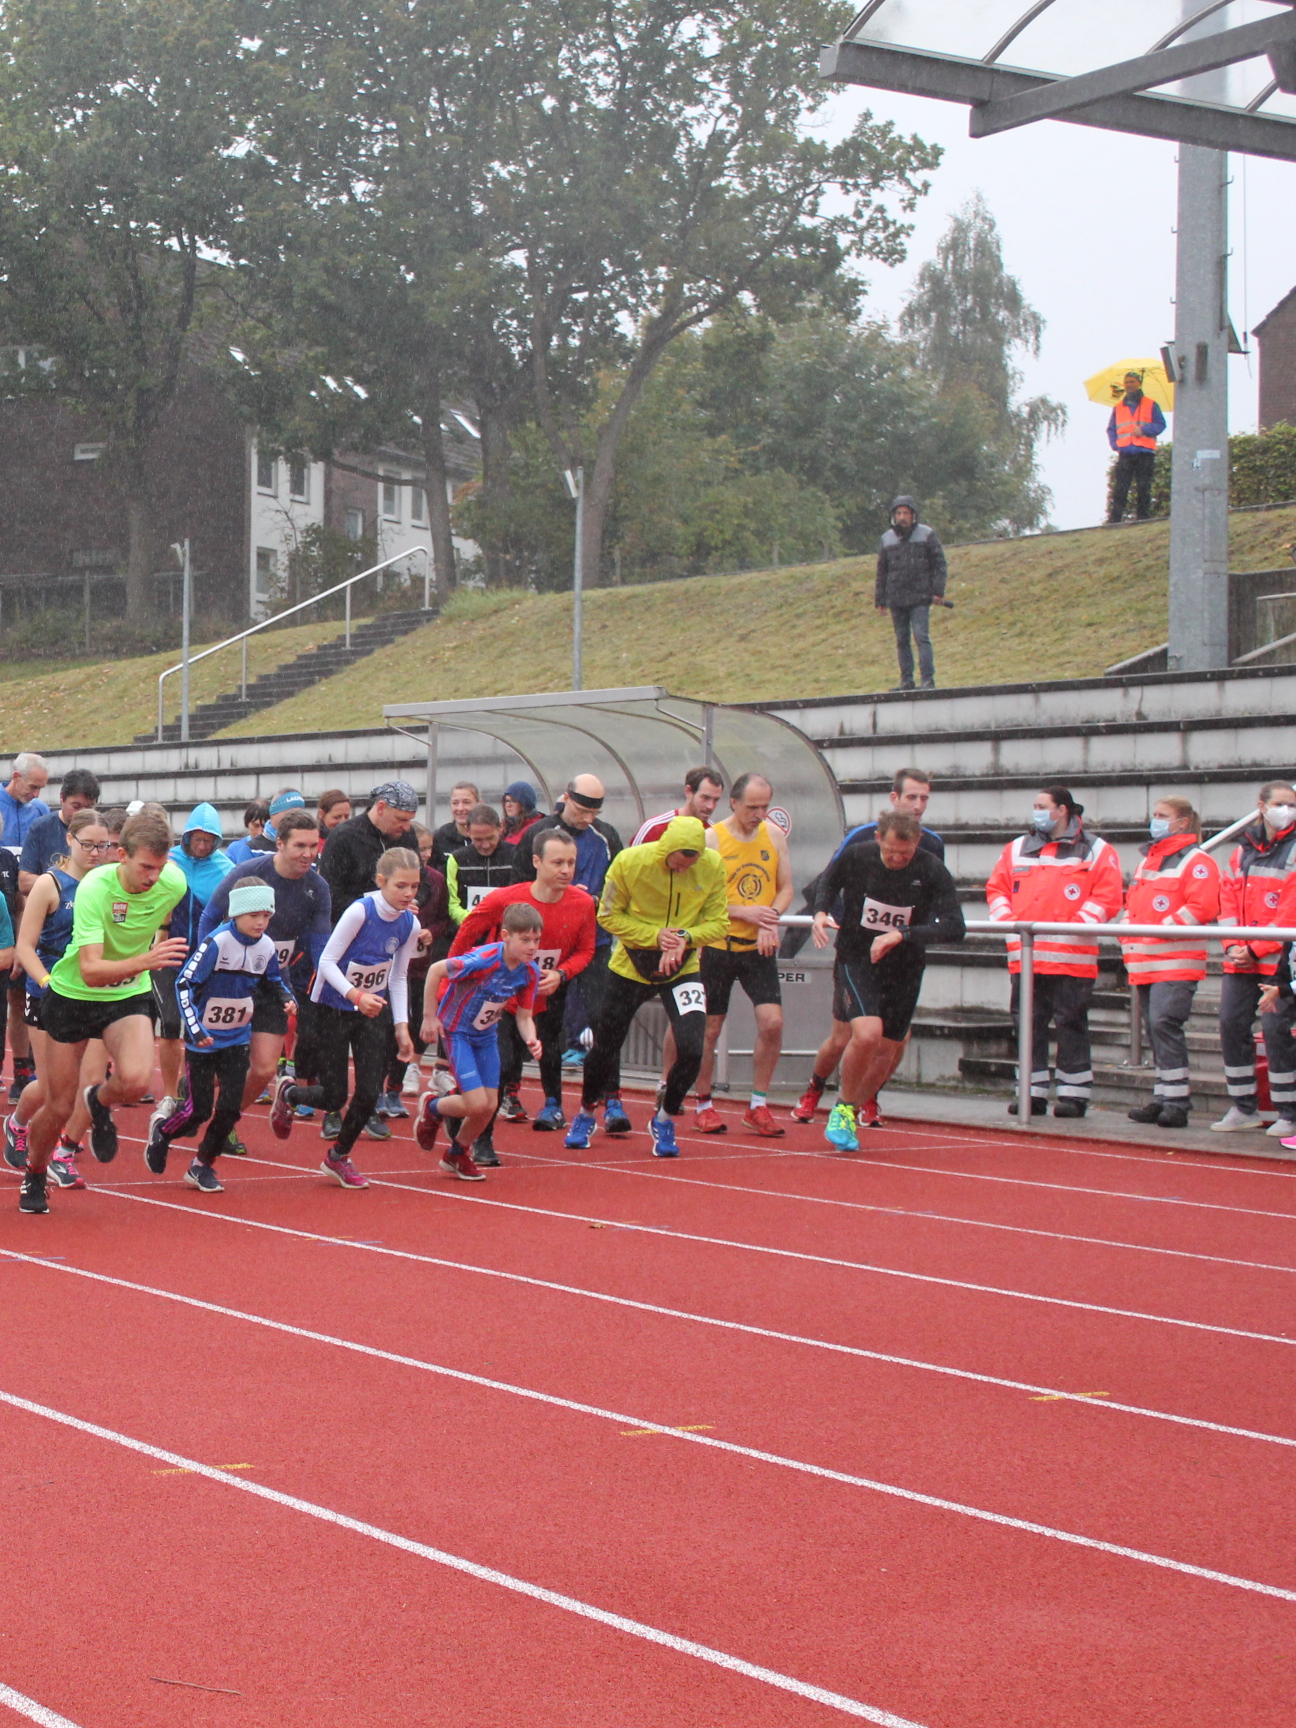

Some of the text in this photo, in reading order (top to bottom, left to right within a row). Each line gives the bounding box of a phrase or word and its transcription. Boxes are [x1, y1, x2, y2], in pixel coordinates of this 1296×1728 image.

[866, 908, 905, 928] 346
[350, 968, 387, 989] 396
[778, 972, 806, 983] PER
[679, 989, 705, 1007] 32
[207, 1005, 247, 1025] 381
